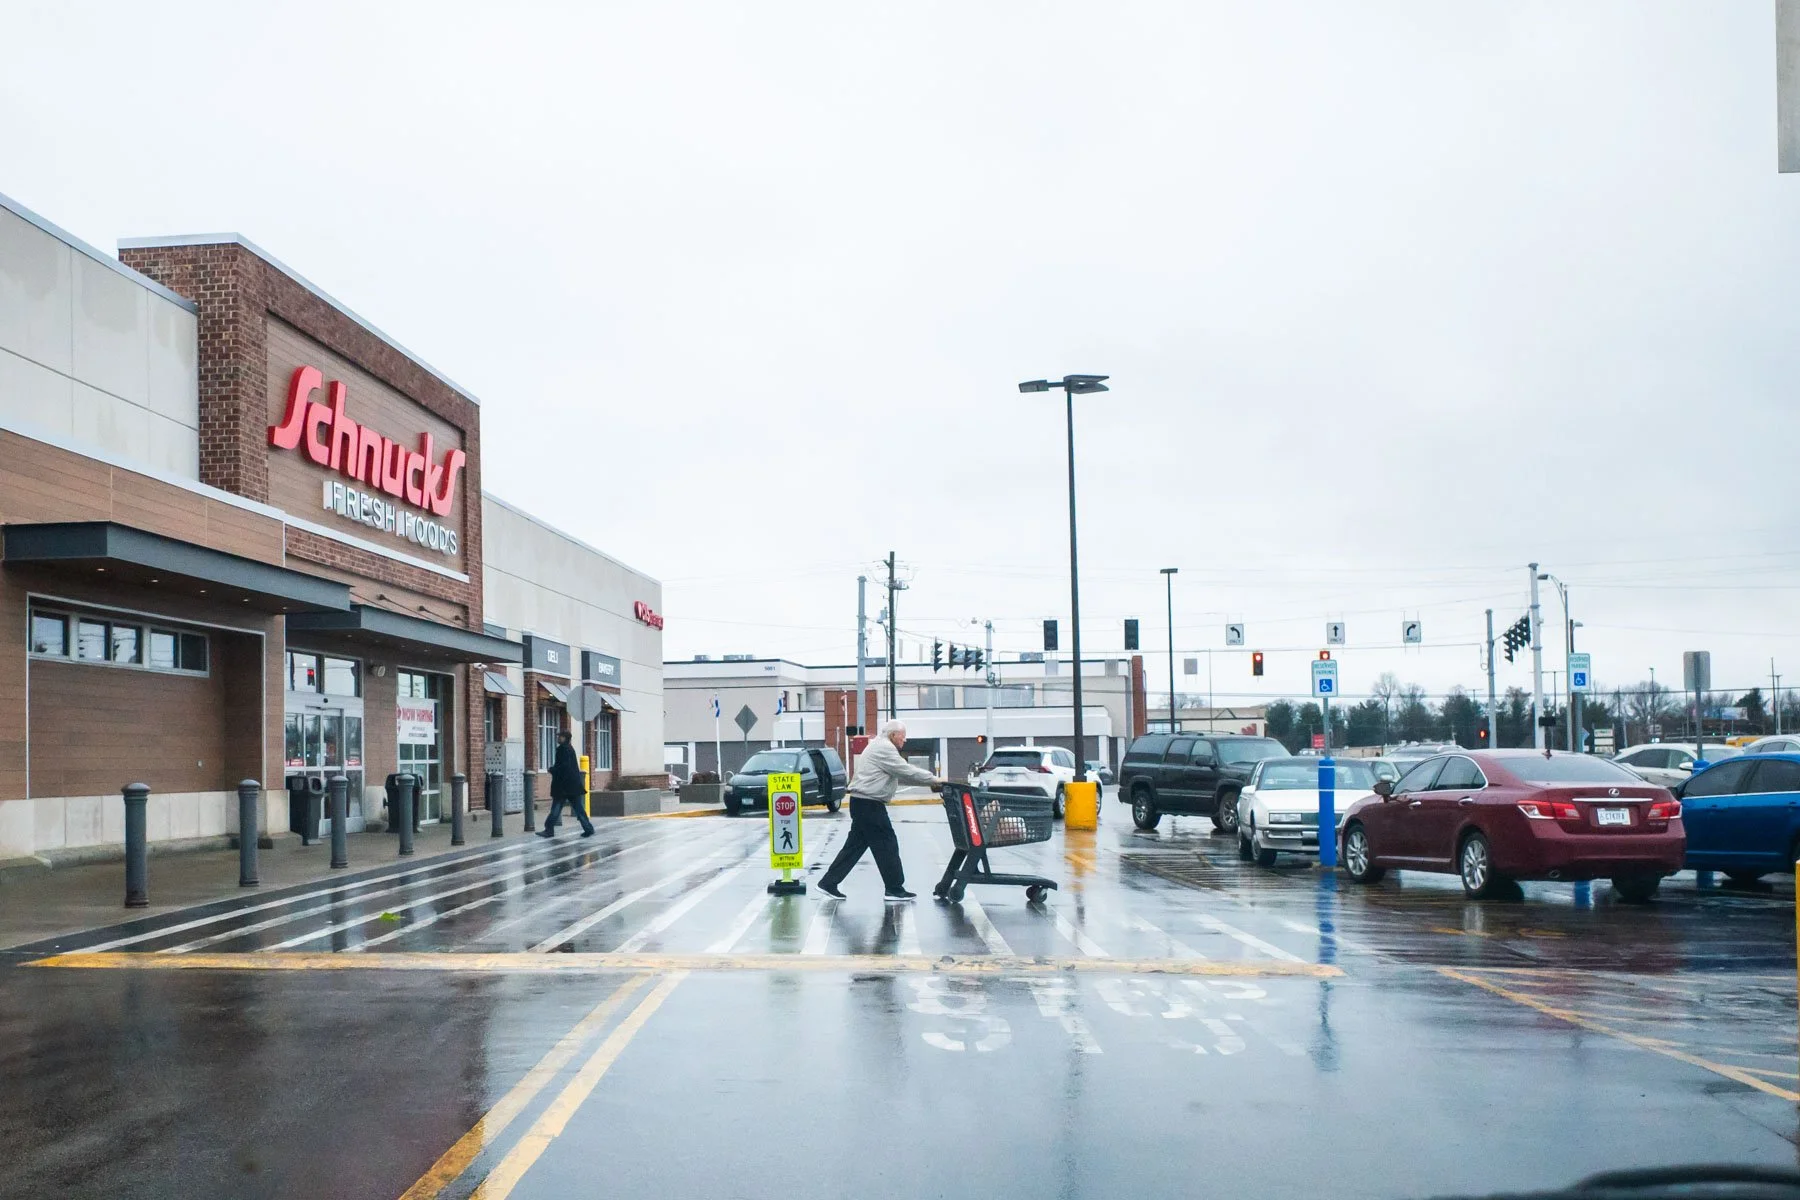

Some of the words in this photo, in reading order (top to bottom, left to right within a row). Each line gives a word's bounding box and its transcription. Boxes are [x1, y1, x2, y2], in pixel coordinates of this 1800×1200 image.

[268, 365, 465, 517] Schnucks
[324, 480, 396, 533] FRESH
[396, 510, 457, 556] FOODS
[547, 649, 559, 665] DELI
[776, 783, 792, 791] LAW
[776, 801, 795, 811] STOP
